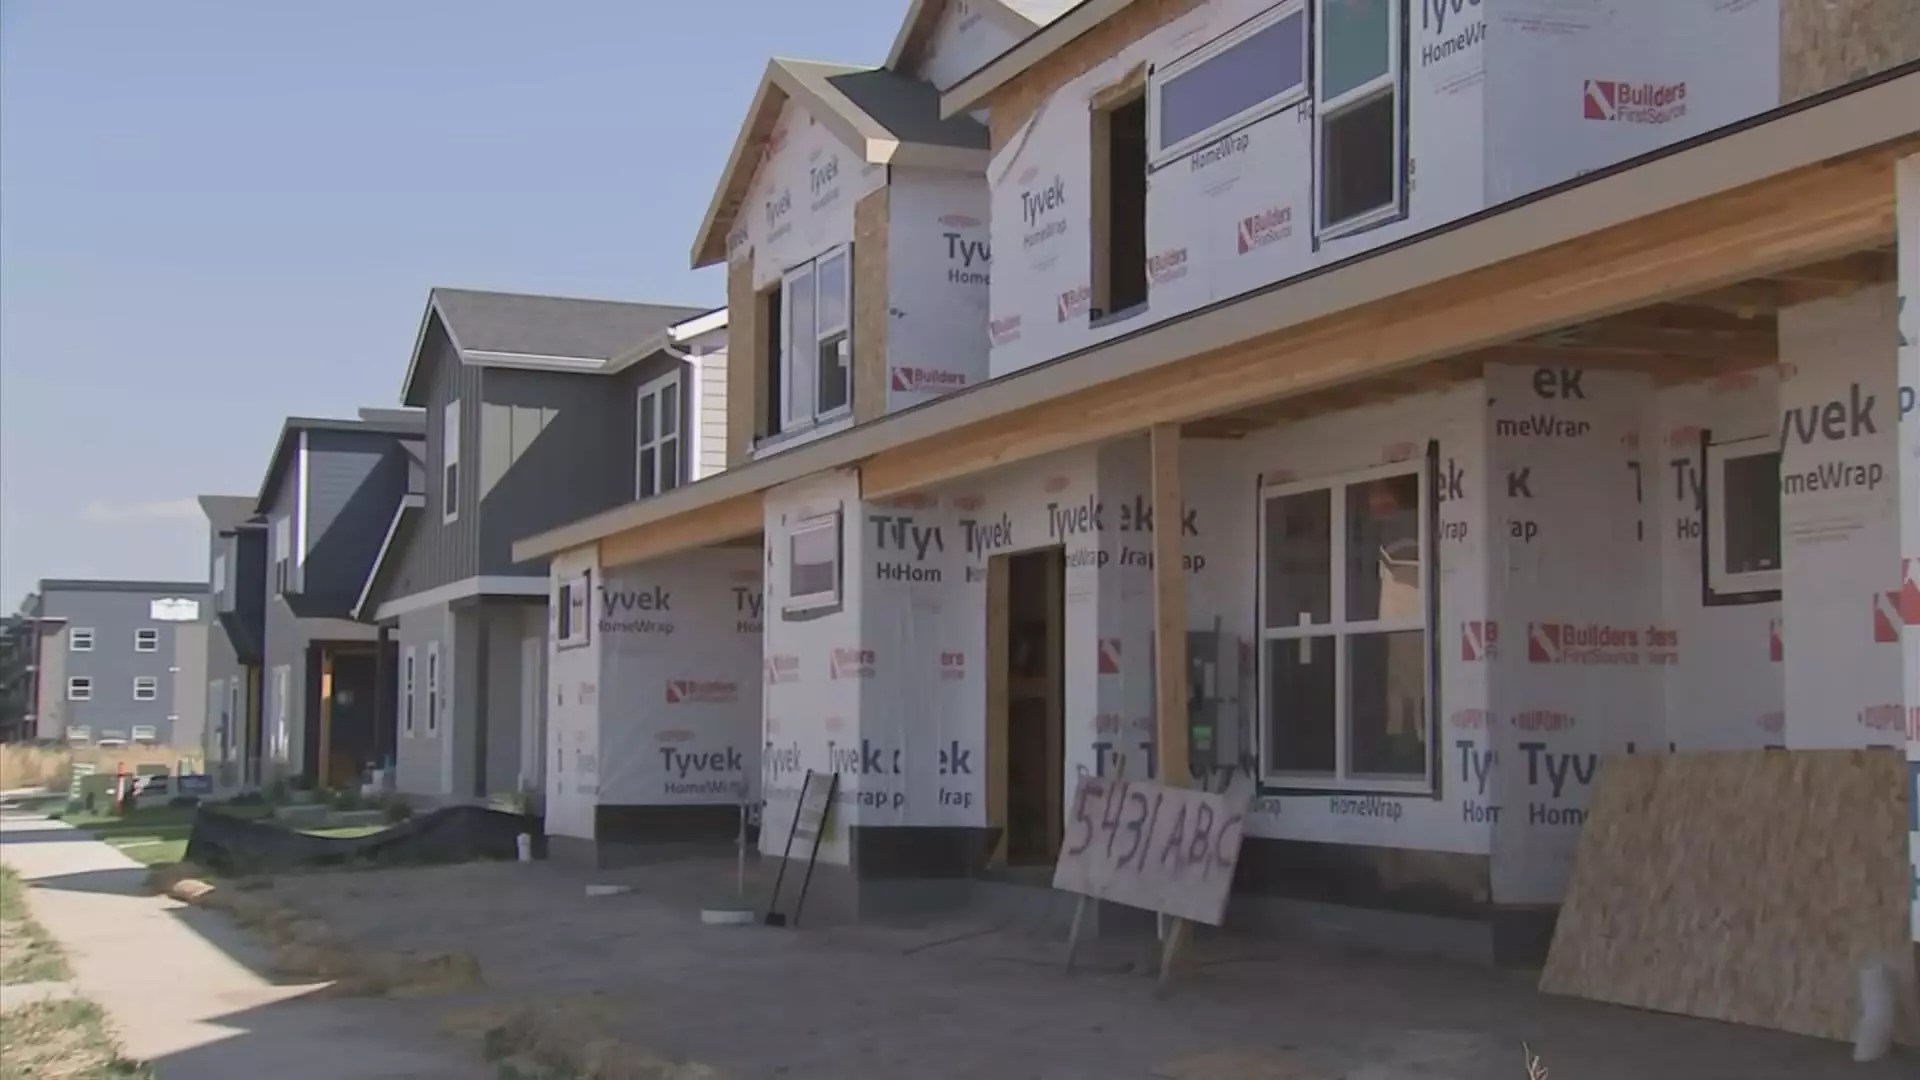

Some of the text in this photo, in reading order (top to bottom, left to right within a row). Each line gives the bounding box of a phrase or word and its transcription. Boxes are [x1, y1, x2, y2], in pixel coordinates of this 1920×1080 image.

[1618, 82, 1686, 106] Builders
[1021, 174, 1065, 227] Tyvek
[959, 512, 1012, 560] Tyvek
[1562, 624, 1638, 646] Builders
[660, 746, 743, 778] Tyvek
[1069, 782, 1163, 872] 5431
